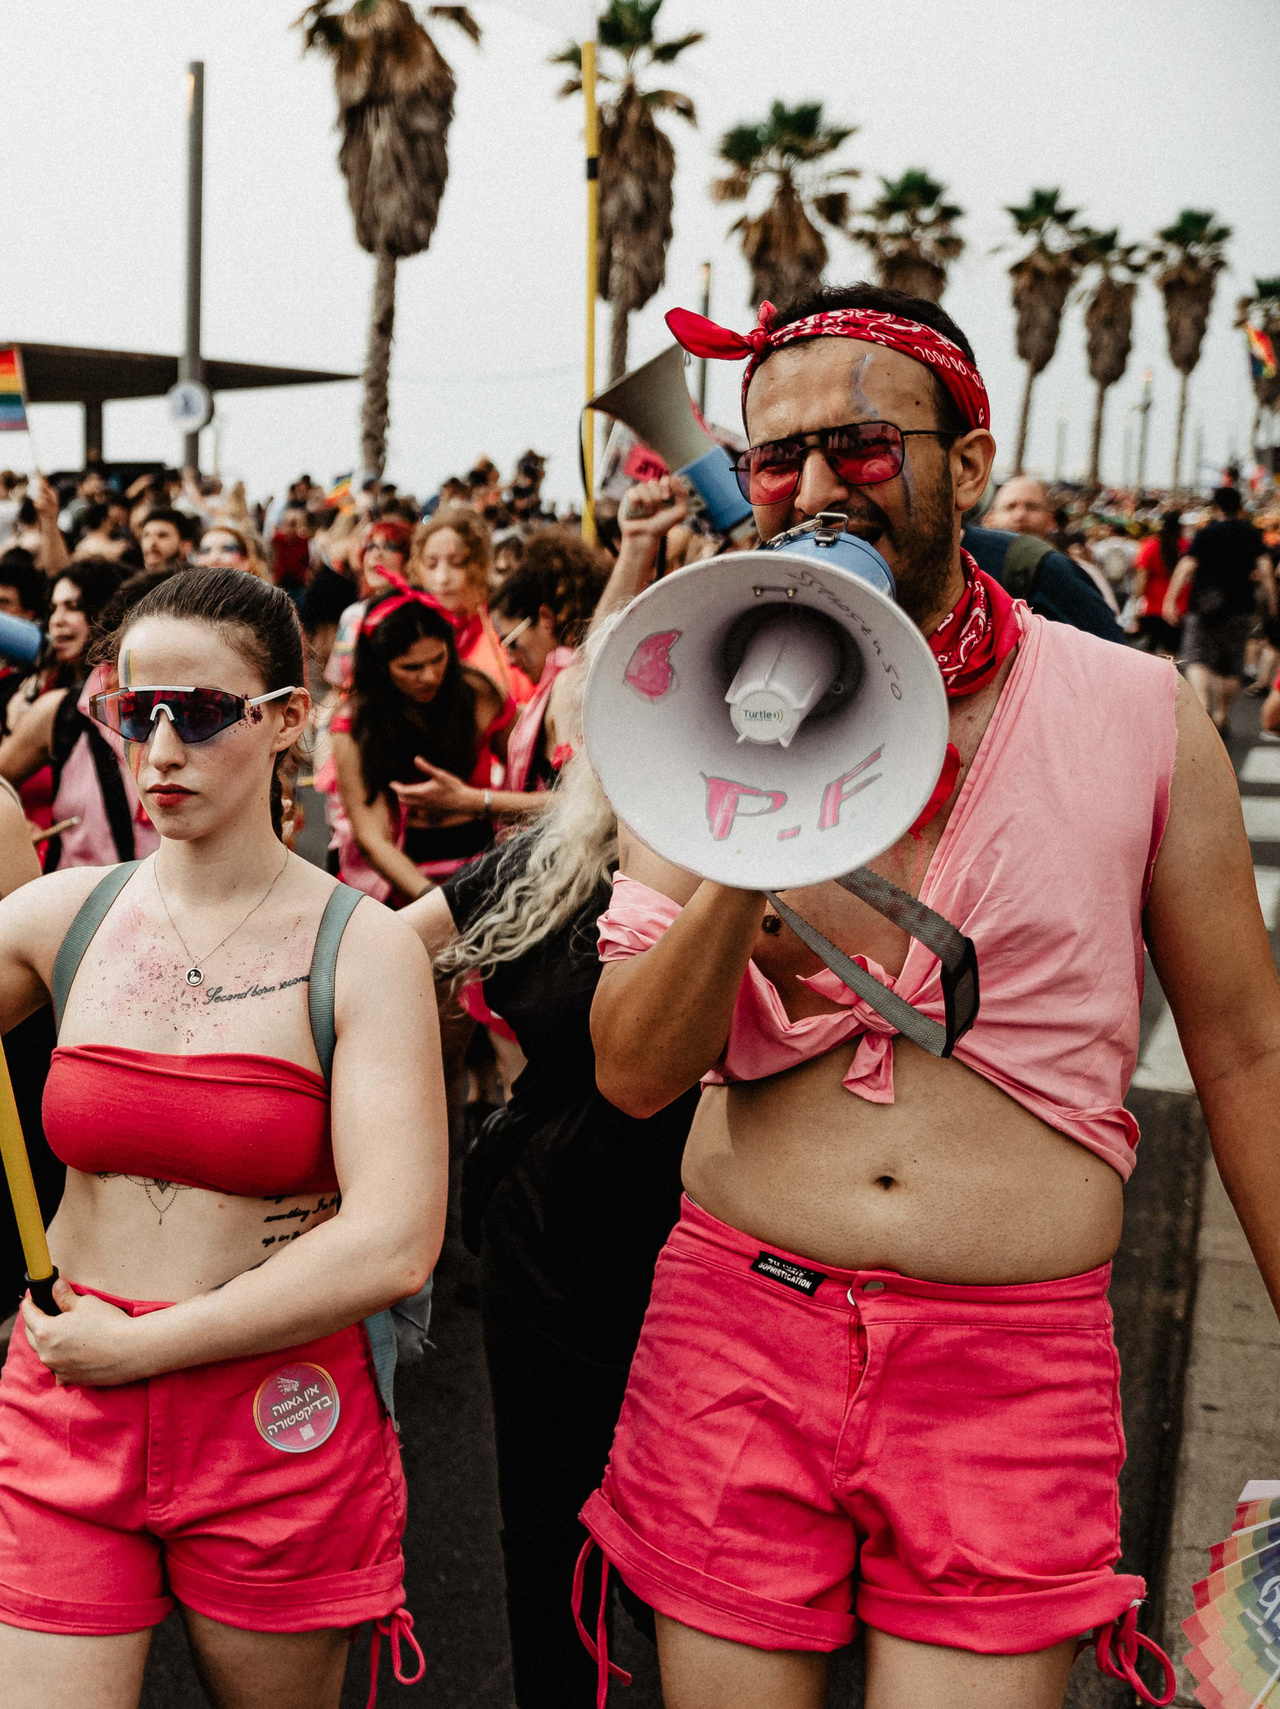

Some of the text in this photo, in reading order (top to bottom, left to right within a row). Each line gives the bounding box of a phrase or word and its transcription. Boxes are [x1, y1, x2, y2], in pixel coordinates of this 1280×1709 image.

[743, 709, 772, 719] Turtle
[699, 743, 886, 841] P.F
[202, 985, 253, 1005] Second
[758, 1262, 812, 1289] SOPHISTICATION
[271, 1384, 320, 1417] אין גאווה
[267, 1396, 332, 1436] בדיקטטורה
